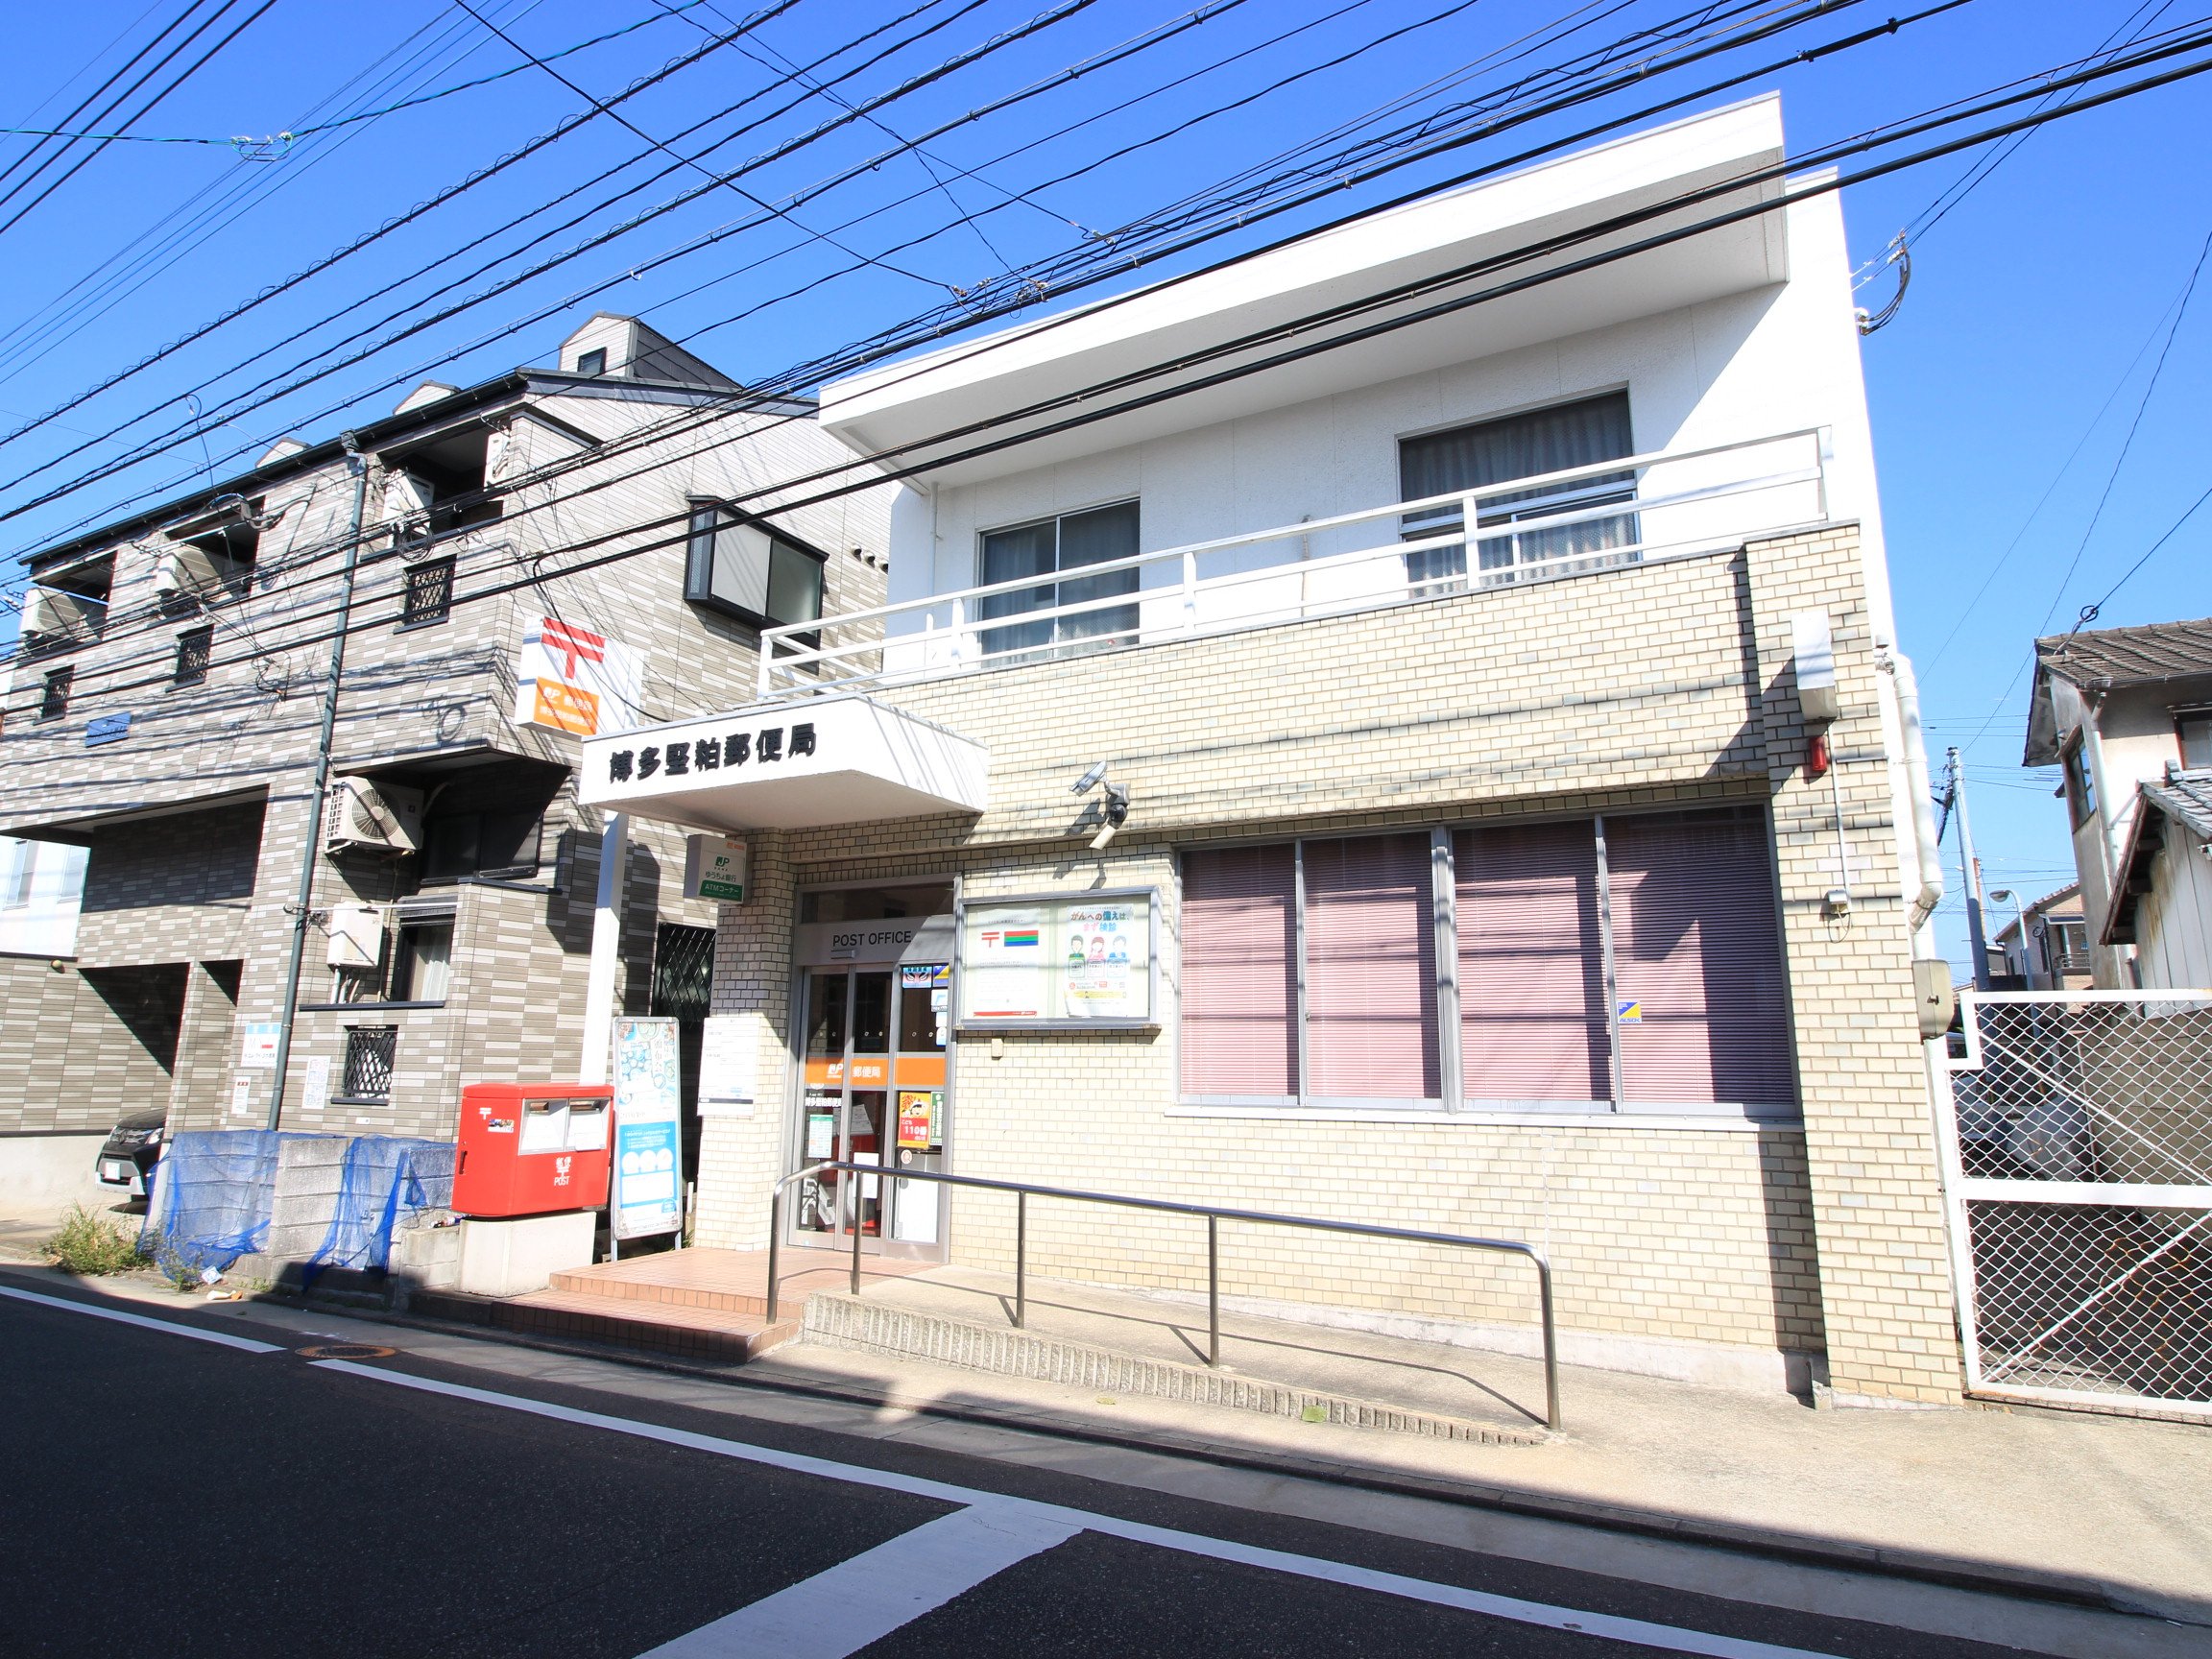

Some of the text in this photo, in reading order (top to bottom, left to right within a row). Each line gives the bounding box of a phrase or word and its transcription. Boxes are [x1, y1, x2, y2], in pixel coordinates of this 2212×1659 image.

[610, 722, 816, 783] 博多堅粕郵便局
[706, 871, 736, 882] ゆうちょ銀行
[705, 883, 738, 894] ATMコーナー
[832, 930, 912, 947] POST OFFICE
[853, 1066, 881, 1078] 郵便局
[554, 1176, 570, 1186] POST
